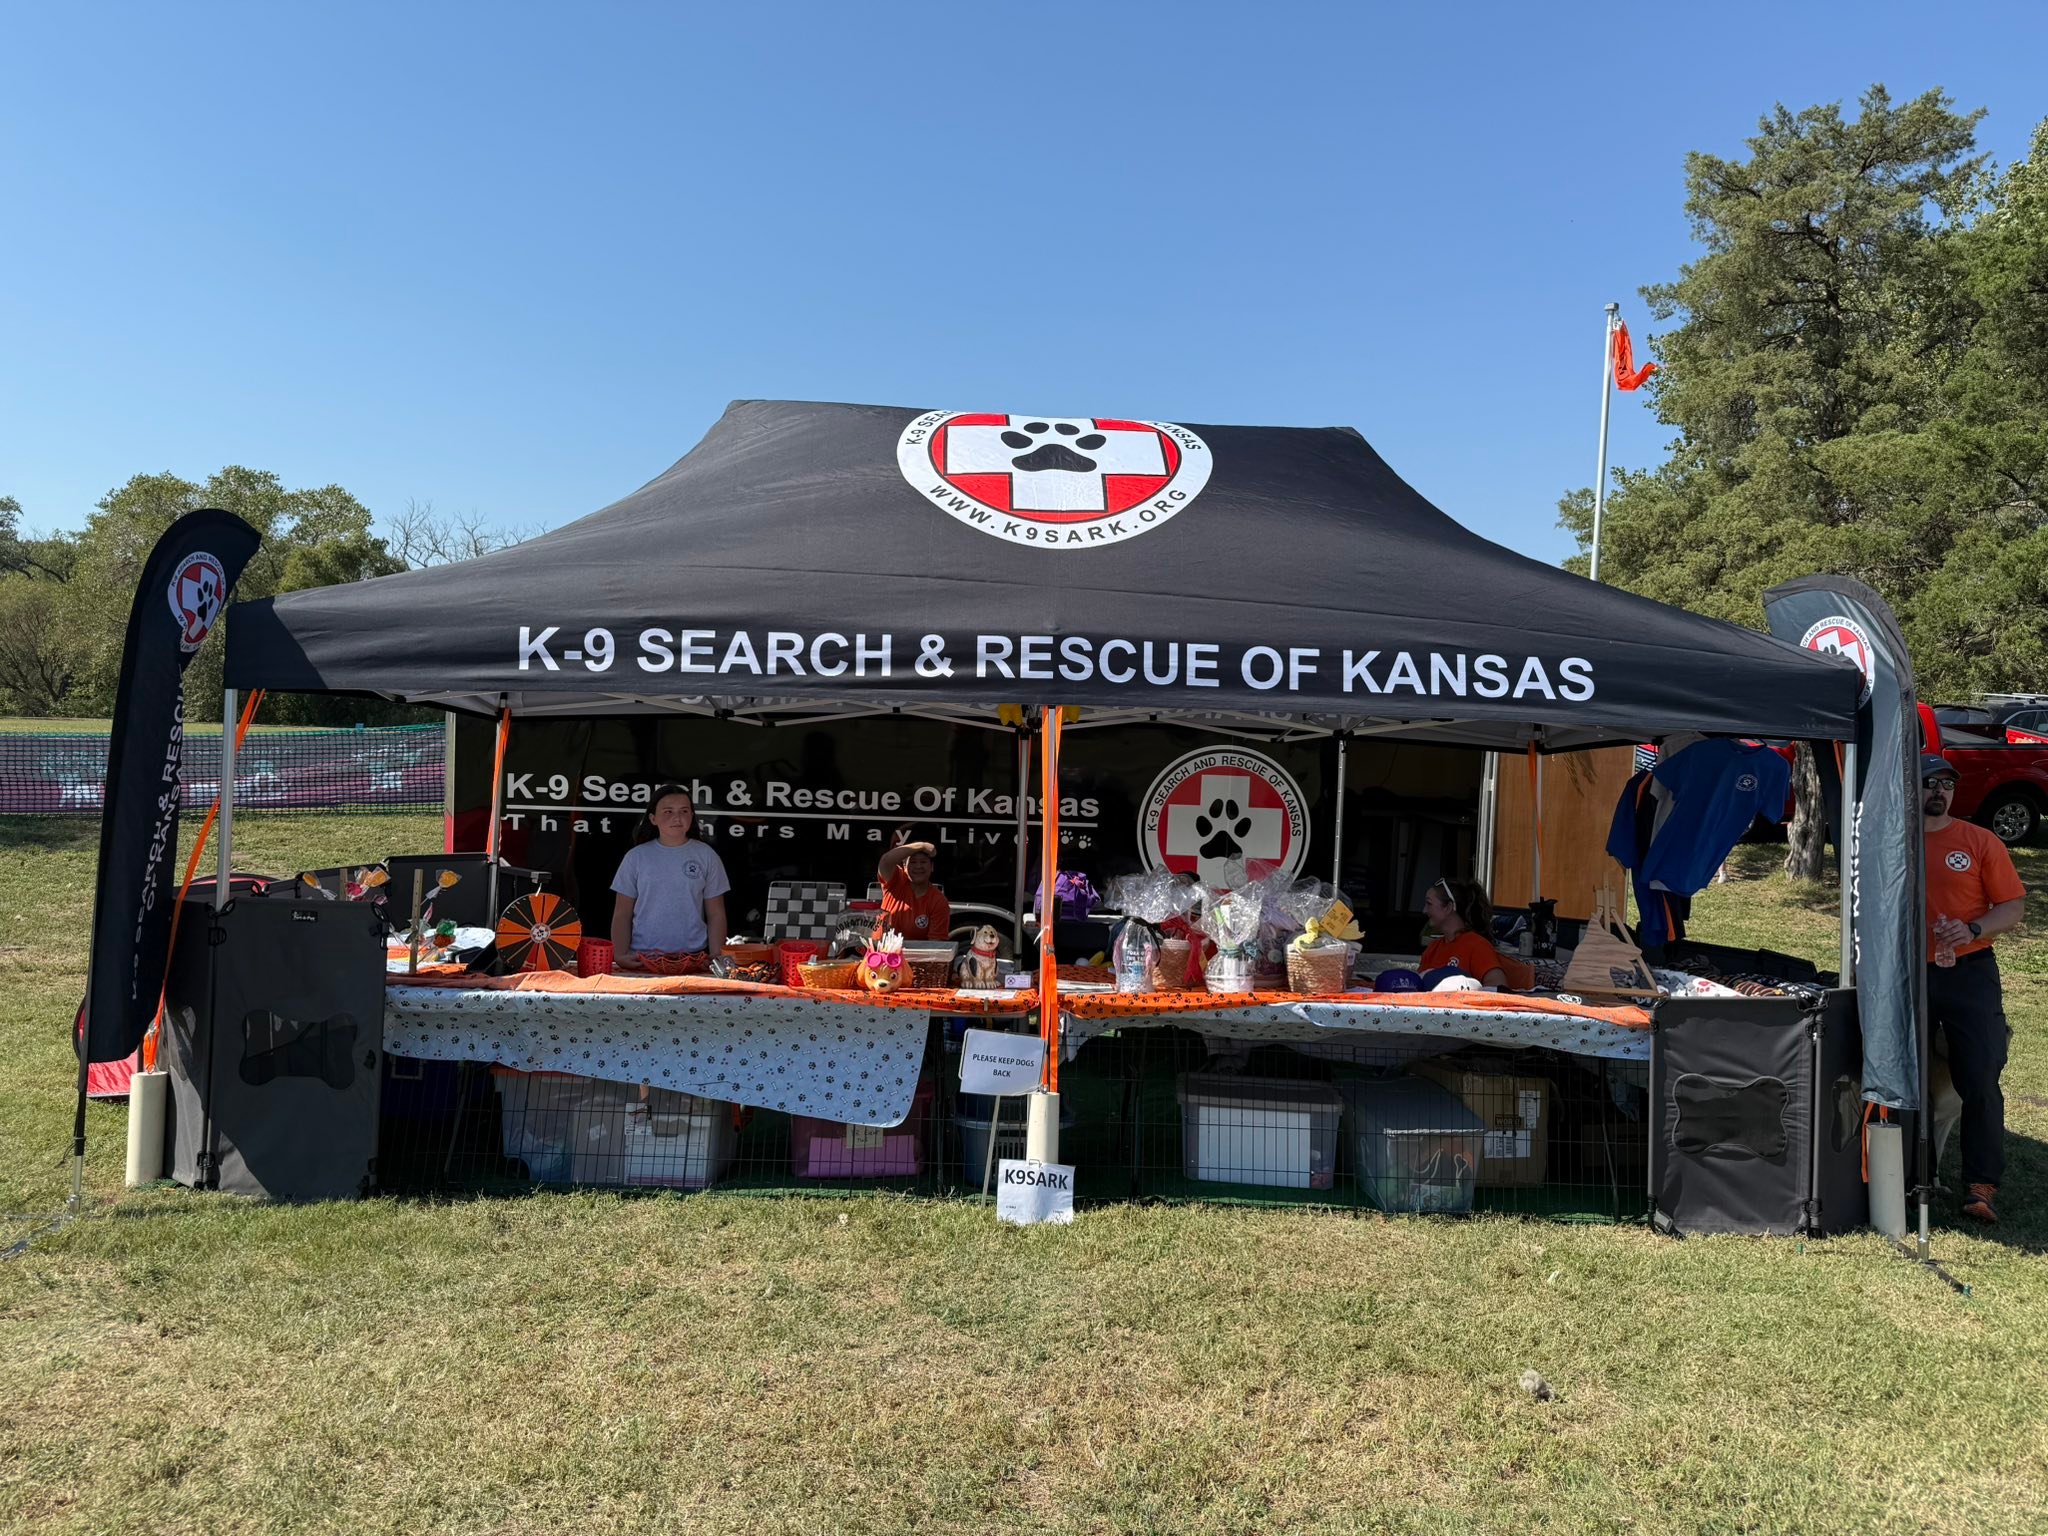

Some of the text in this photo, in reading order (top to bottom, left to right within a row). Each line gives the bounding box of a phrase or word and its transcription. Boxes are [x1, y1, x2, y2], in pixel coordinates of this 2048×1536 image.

[905, 429, 927, 445] K-9
[929, 485, 1187, 544] WWW.K9SARK.ORG
[1820, 618, 1845, 628] RESCUE
[1852, 624, 1870, 651] KANSAS
[518, 626, 1596, 702] K-9 SEARCH & RESCUE OF KANSAS
[158, 791, 170, 811] &
[506, 772, 1100, 818] K-9 Seah & Rescue Of Kanas
[1147, 755, 1302, 838] K-9 SEARCH AND RESCUE OF KANSAS
[505, 813, 612, 834] That
[698, 819, 796, 839] hers
[826, 823, 912, 846] May
[972, 1053, 1035, 1067] PLEASE KEEP DOGS
[992, 1069, 1011, 1078] BACK
[1004, 1168, 1068, 1190] K9SARK
